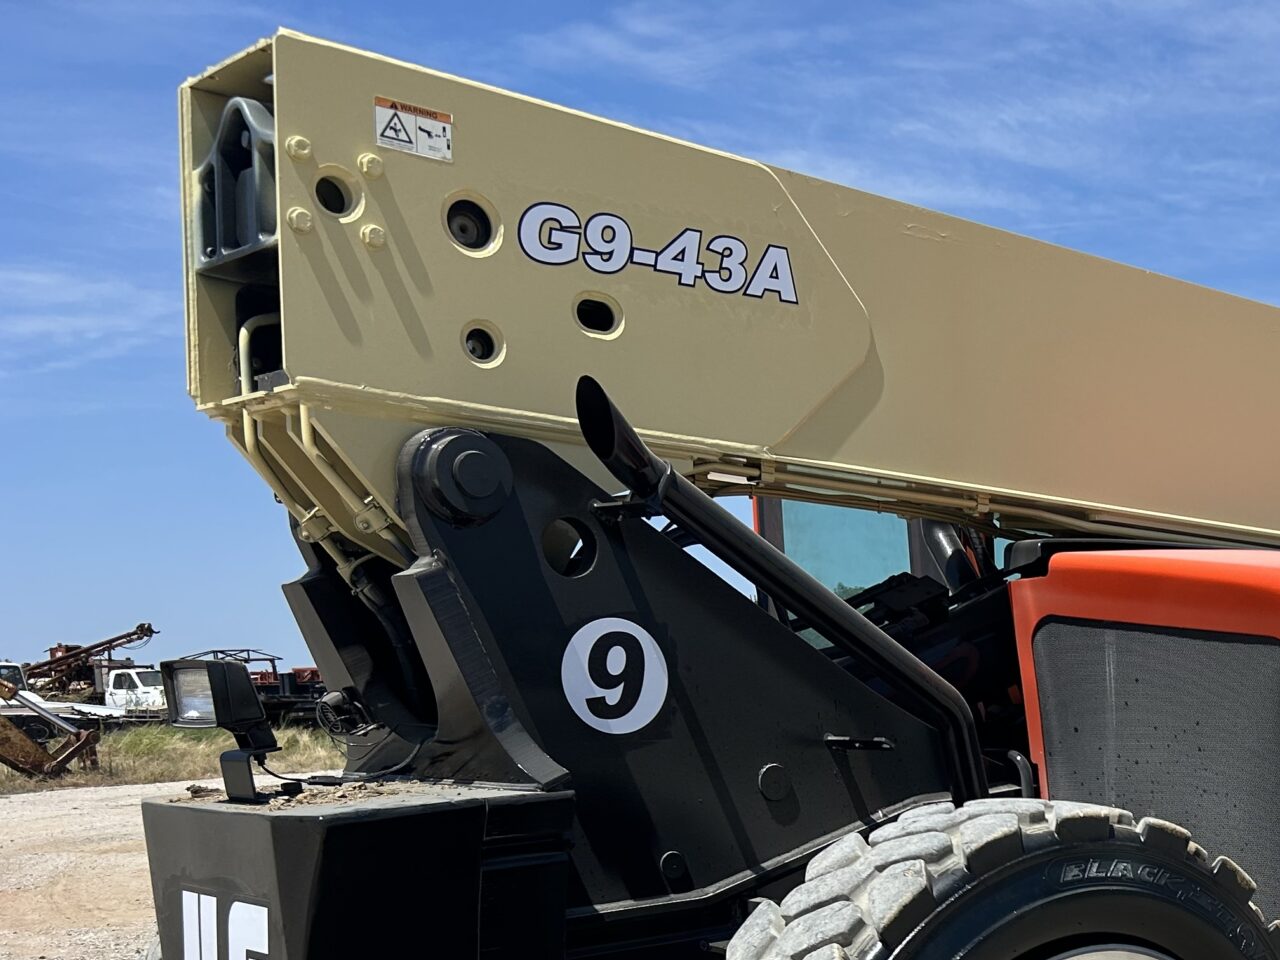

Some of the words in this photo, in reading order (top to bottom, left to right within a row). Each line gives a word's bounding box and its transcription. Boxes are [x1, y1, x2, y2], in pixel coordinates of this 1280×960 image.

[400, 104, 438, 119] WARNING
[517, 201, 799, 305] G9-43A
[584, 630, 646, 720] 9
